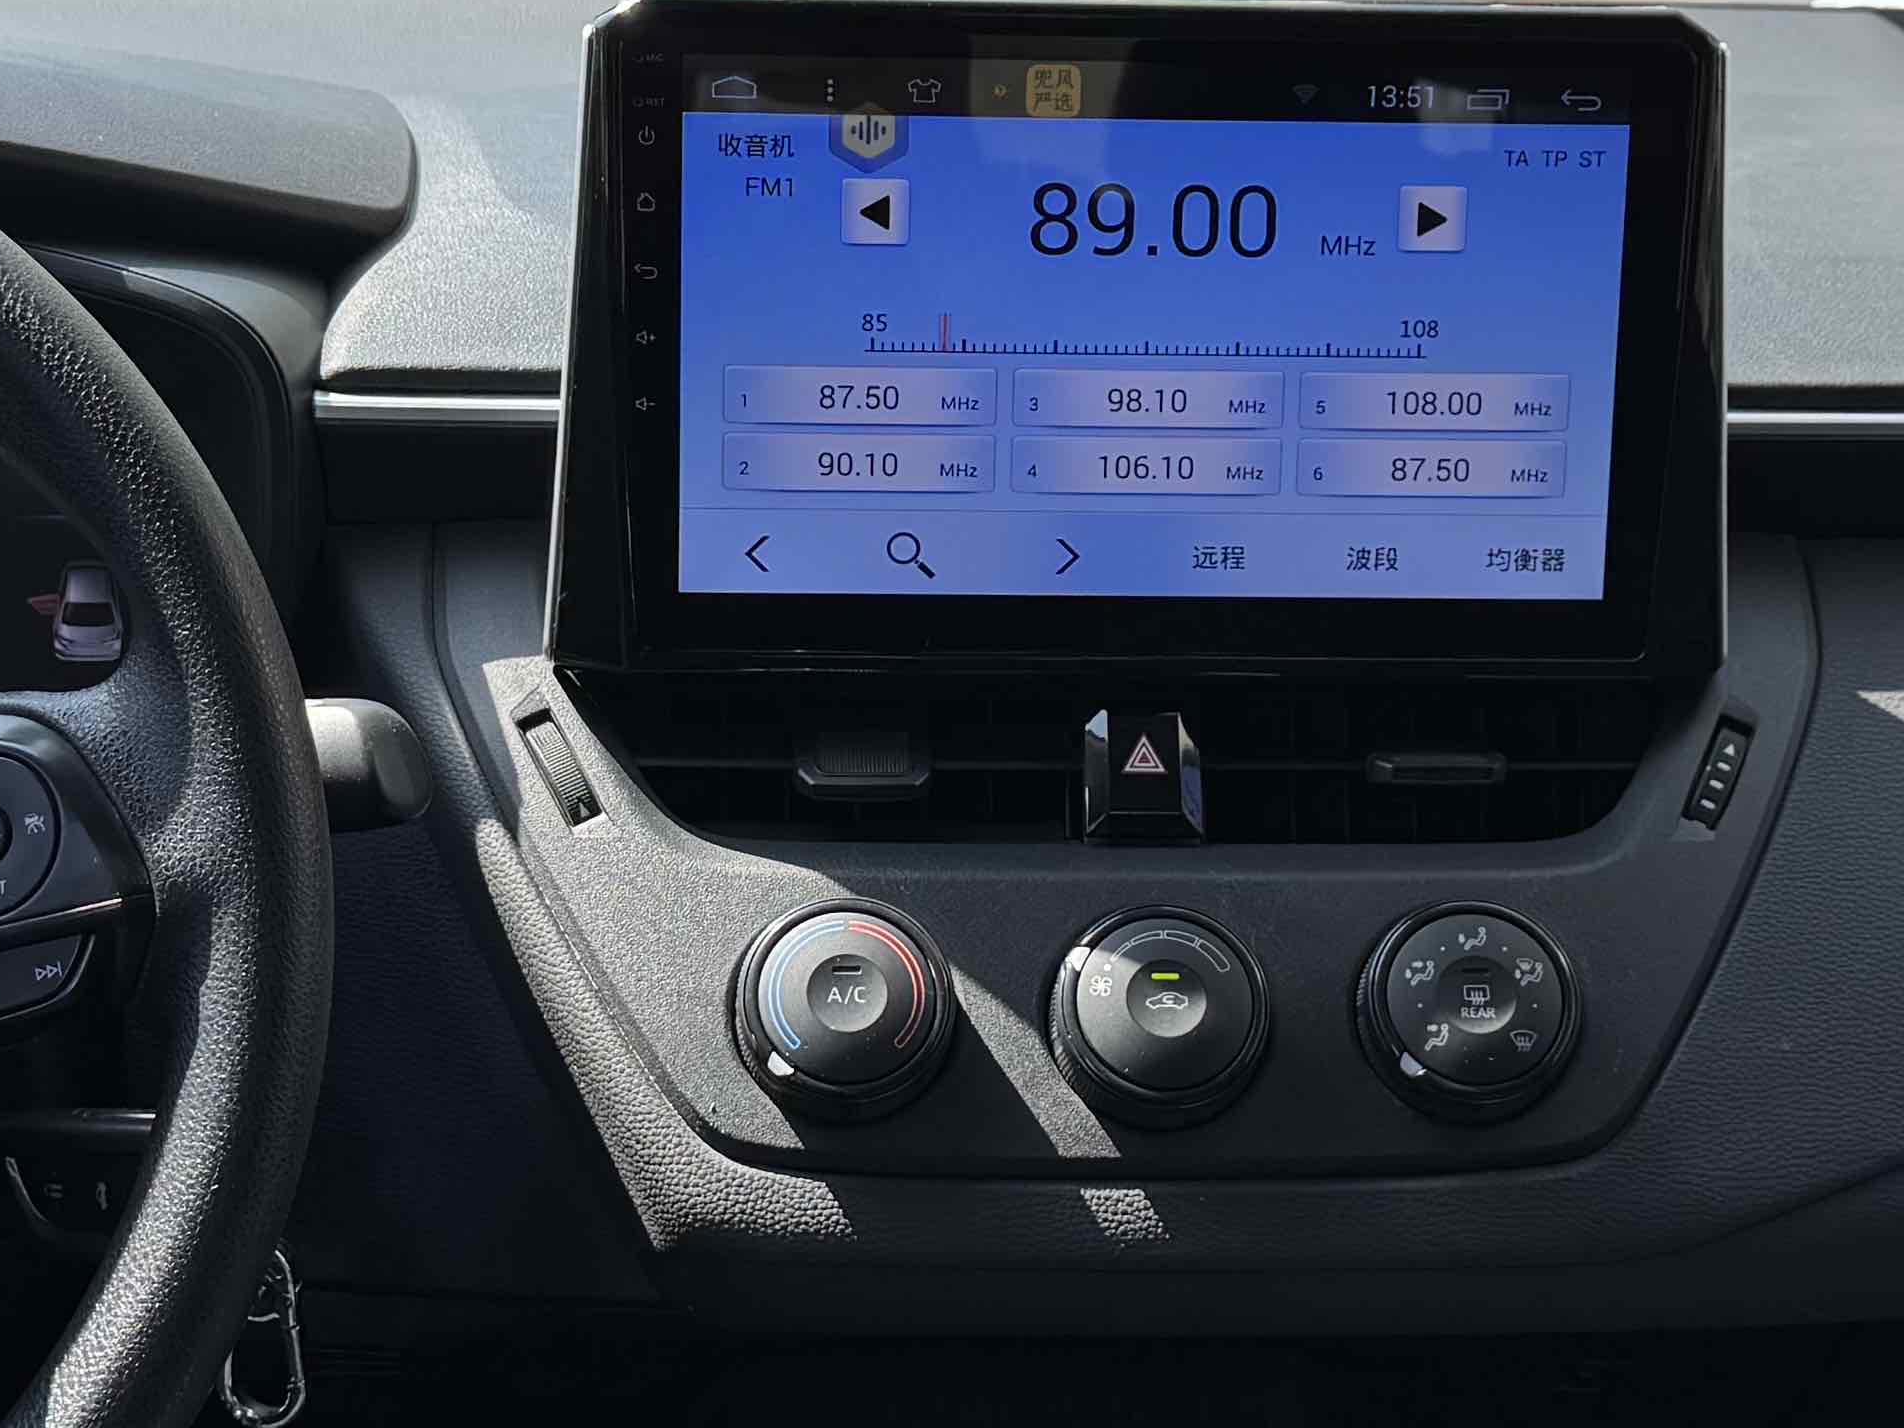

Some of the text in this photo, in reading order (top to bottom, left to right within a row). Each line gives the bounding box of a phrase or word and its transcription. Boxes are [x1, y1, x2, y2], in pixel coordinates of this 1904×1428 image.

[1367, 84, 1436, 110] 13:51
[718, 132, 795, 159] 收音机
[1504, 149, 1607, 169] TA TP ST
[746, 176, 794, 198] FM1
[1028, 180, 1377, 259] 89.00 MHz
[861, 312, 888, 334] 85
[1400, 319, 1441, 341] 108
[740, 384, 980, 412] 1 87.50 MHz
[1029, 388, 1266, 414] 3 98.10 MHz
[1315, 390, 1552, 417] 5 108.00 MHz
[738, 451, 979, 479] 2 90.10 MHz
[1027, 454, 1265, 481] 4 106.10 MHz
[1313, 457, 1549, 484] 6 87.50 MHz
[1192, 544, 1247, 572] 远程
[1345, 545, 1400, 573] 波段
[1485, 546, 1567, 574] 均衡器
[827, 985, 866, 1005] A/C
[1460, 1006, 1496, 1019] REAR
